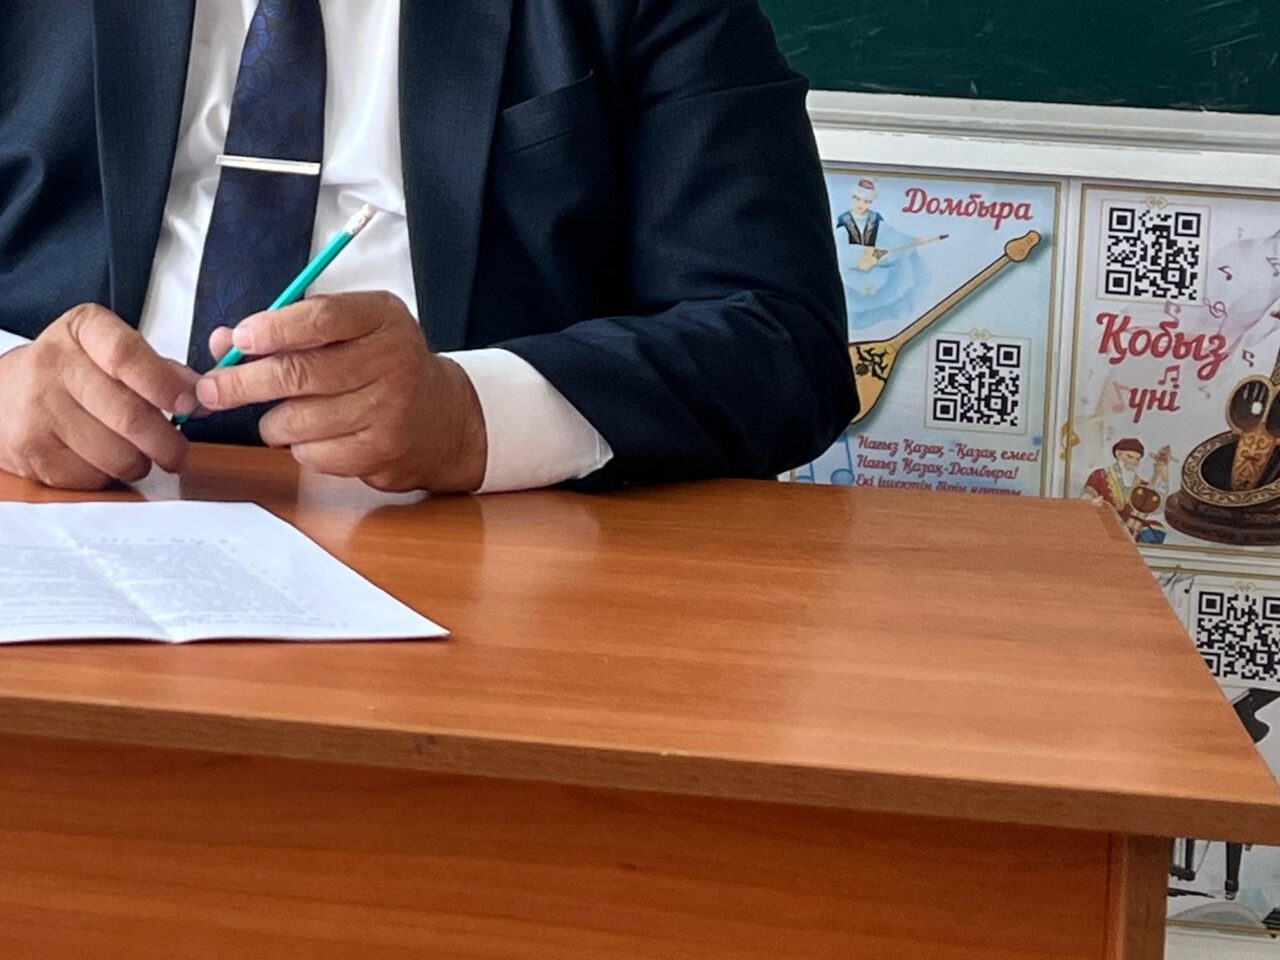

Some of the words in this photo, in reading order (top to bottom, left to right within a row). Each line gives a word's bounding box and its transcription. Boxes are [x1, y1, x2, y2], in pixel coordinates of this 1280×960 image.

[902, 187, 1034, 230] Домбыра
[1096, 312, 1229, 381] Қобыз
[1128, 383, 1181, 424] үні
[856, 454, 898, 476] Нағыз
[858, 435, 898, 457] Нағыз
[903, 438, 944, 459] Қазақ
[1001, 449, 1040, 462] емес!
[856, 473, 874, 487] Екі
